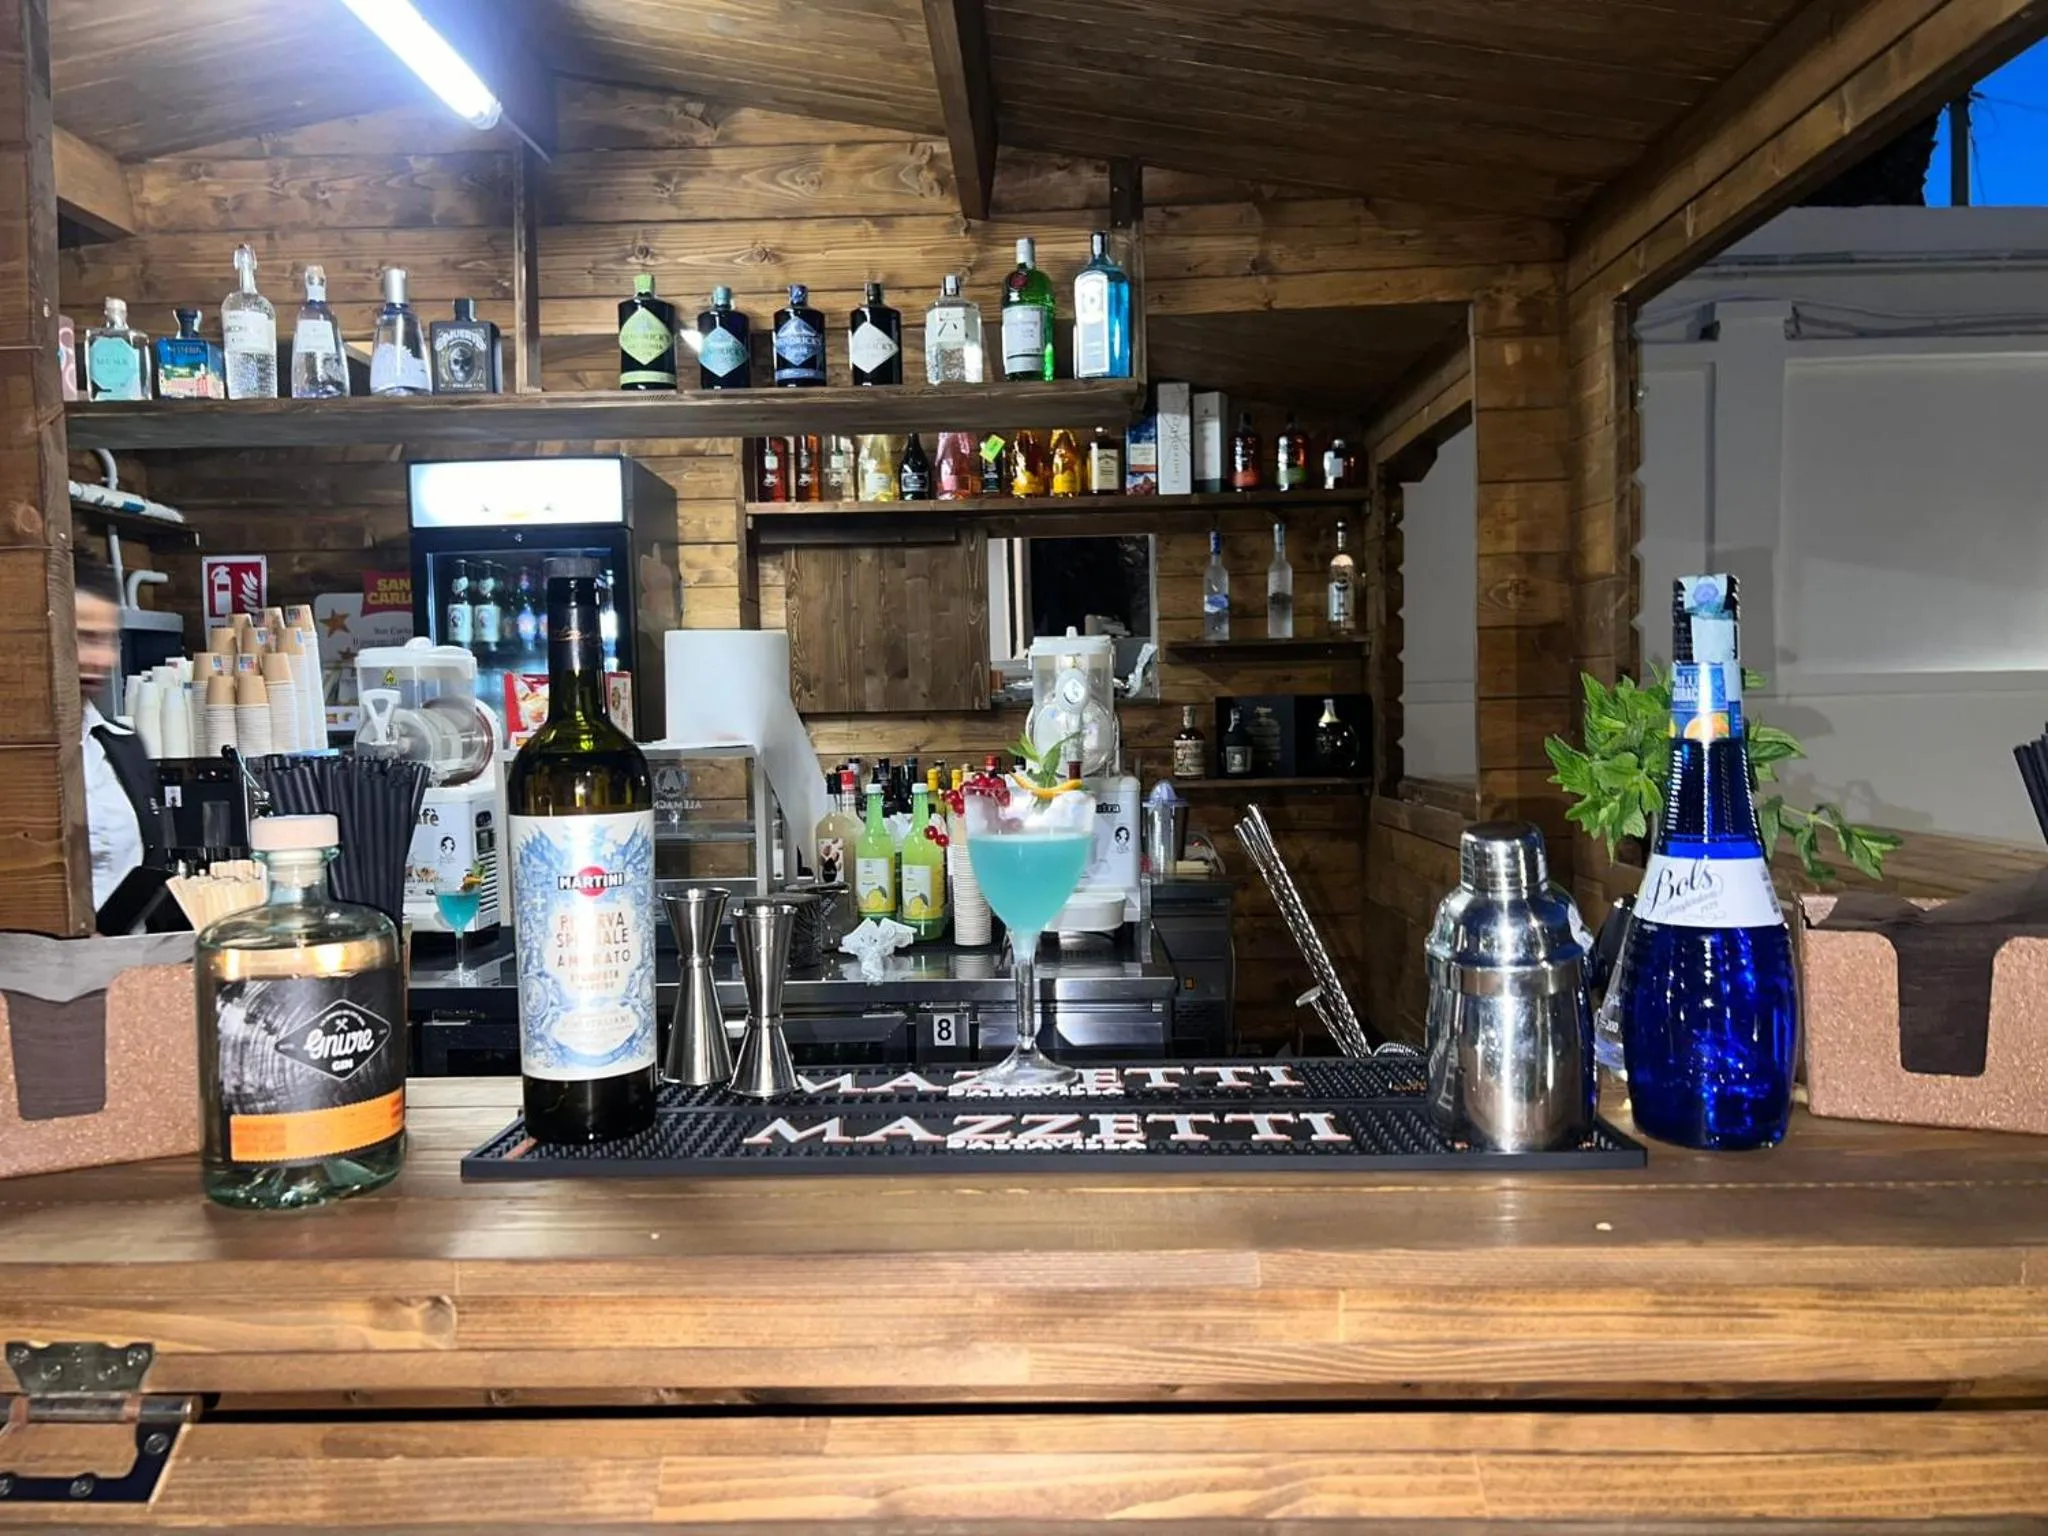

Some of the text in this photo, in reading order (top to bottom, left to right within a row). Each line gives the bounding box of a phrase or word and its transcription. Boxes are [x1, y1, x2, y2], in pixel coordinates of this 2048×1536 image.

[376, 578, 411, 592] SAN
[558, 871, 625, 890] MARTINI
[937, 1018, 952, 1041] 8
[331, 1058, 355, 1072] GIN
[742, 1112, 1352, 1144] MAZZETTI
